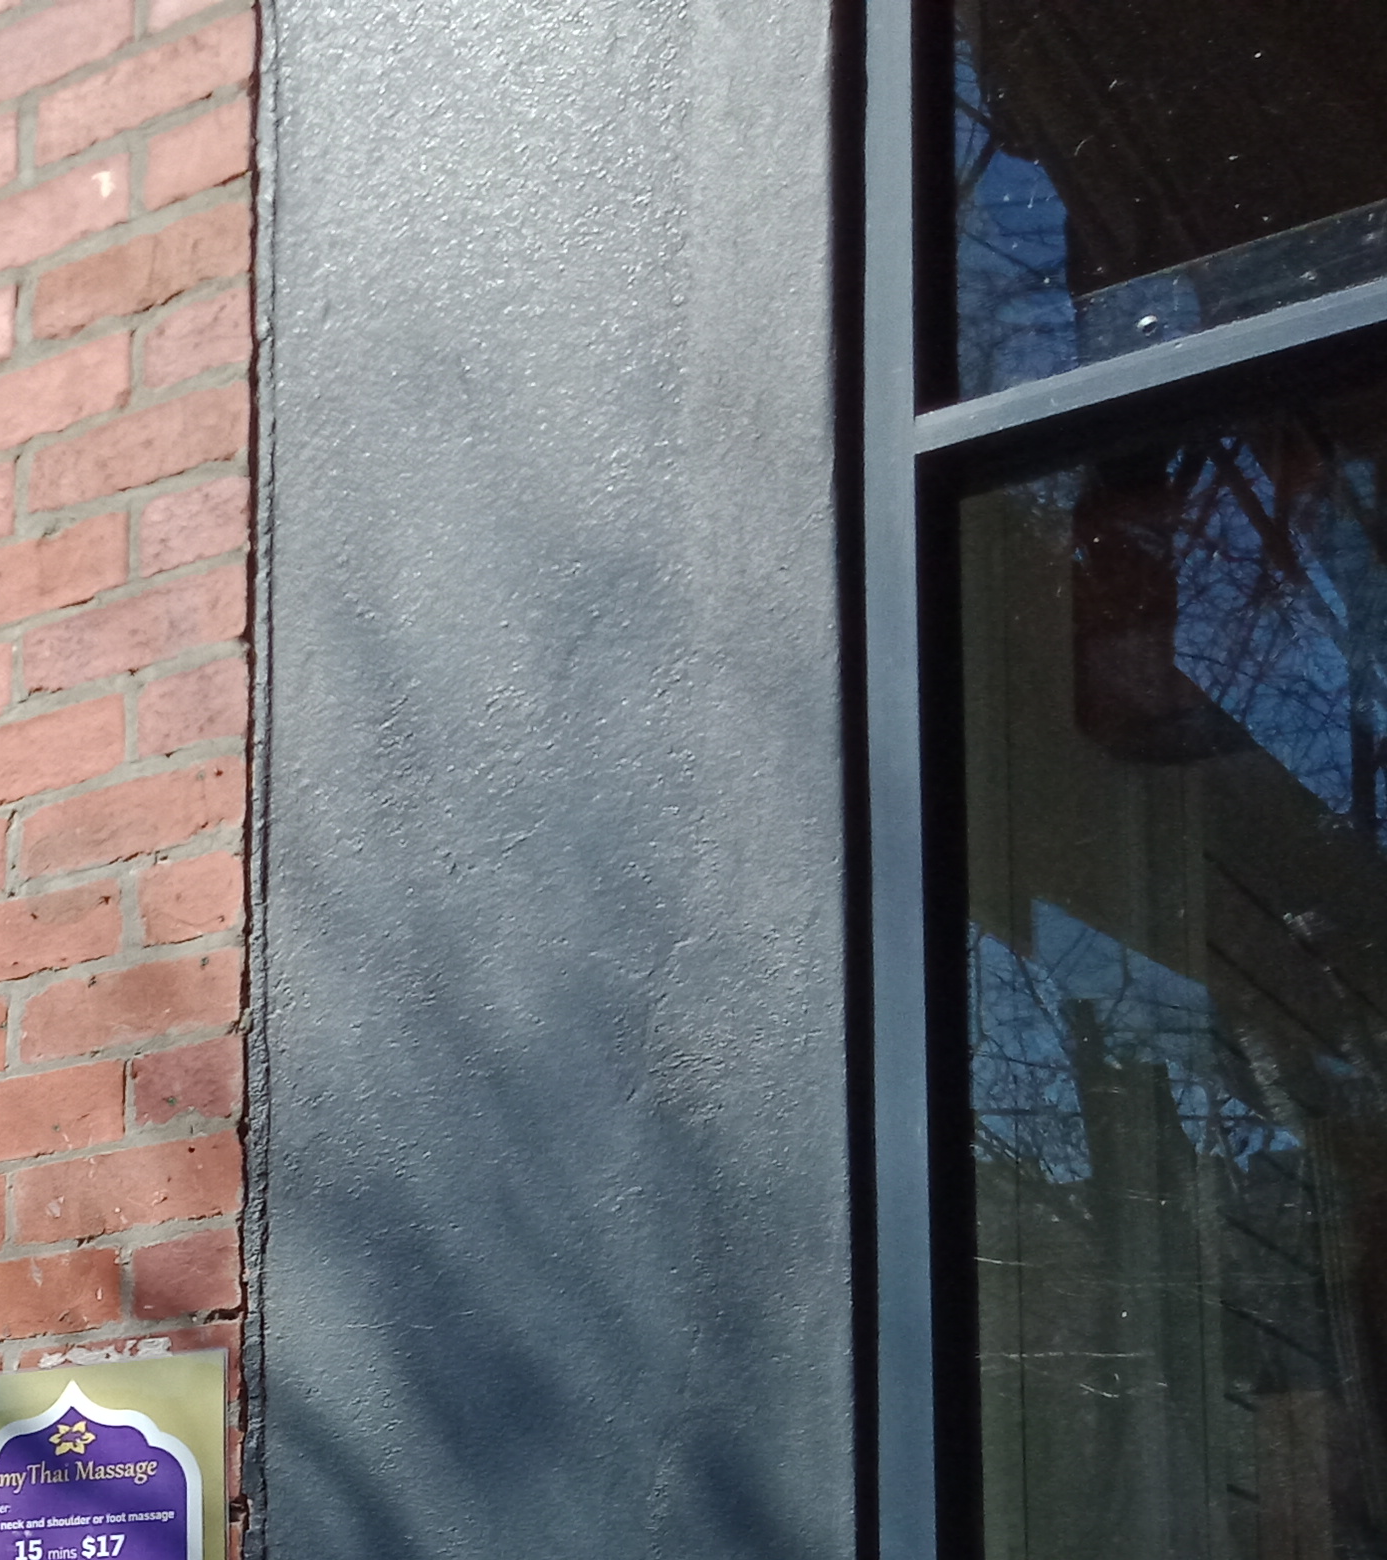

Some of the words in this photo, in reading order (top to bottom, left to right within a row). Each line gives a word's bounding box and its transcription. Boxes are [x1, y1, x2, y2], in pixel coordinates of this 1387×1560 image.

[27, 1461, 70, 1485] Thai
[76, 1460, 158, 1485] Massage
[0, 1519, 24, 1530] neck
[26, 1517, 45, 1528] and
[47, 1515, 91, 1528] shoulder
[93, 1515, 104, 1524] or
[106, 1512, 127, 1524] foot
[128, 1510, 175, 1523] massage
[47, 1547, 77, 1560] mins
[81, 1534, 125, 1560] $17
